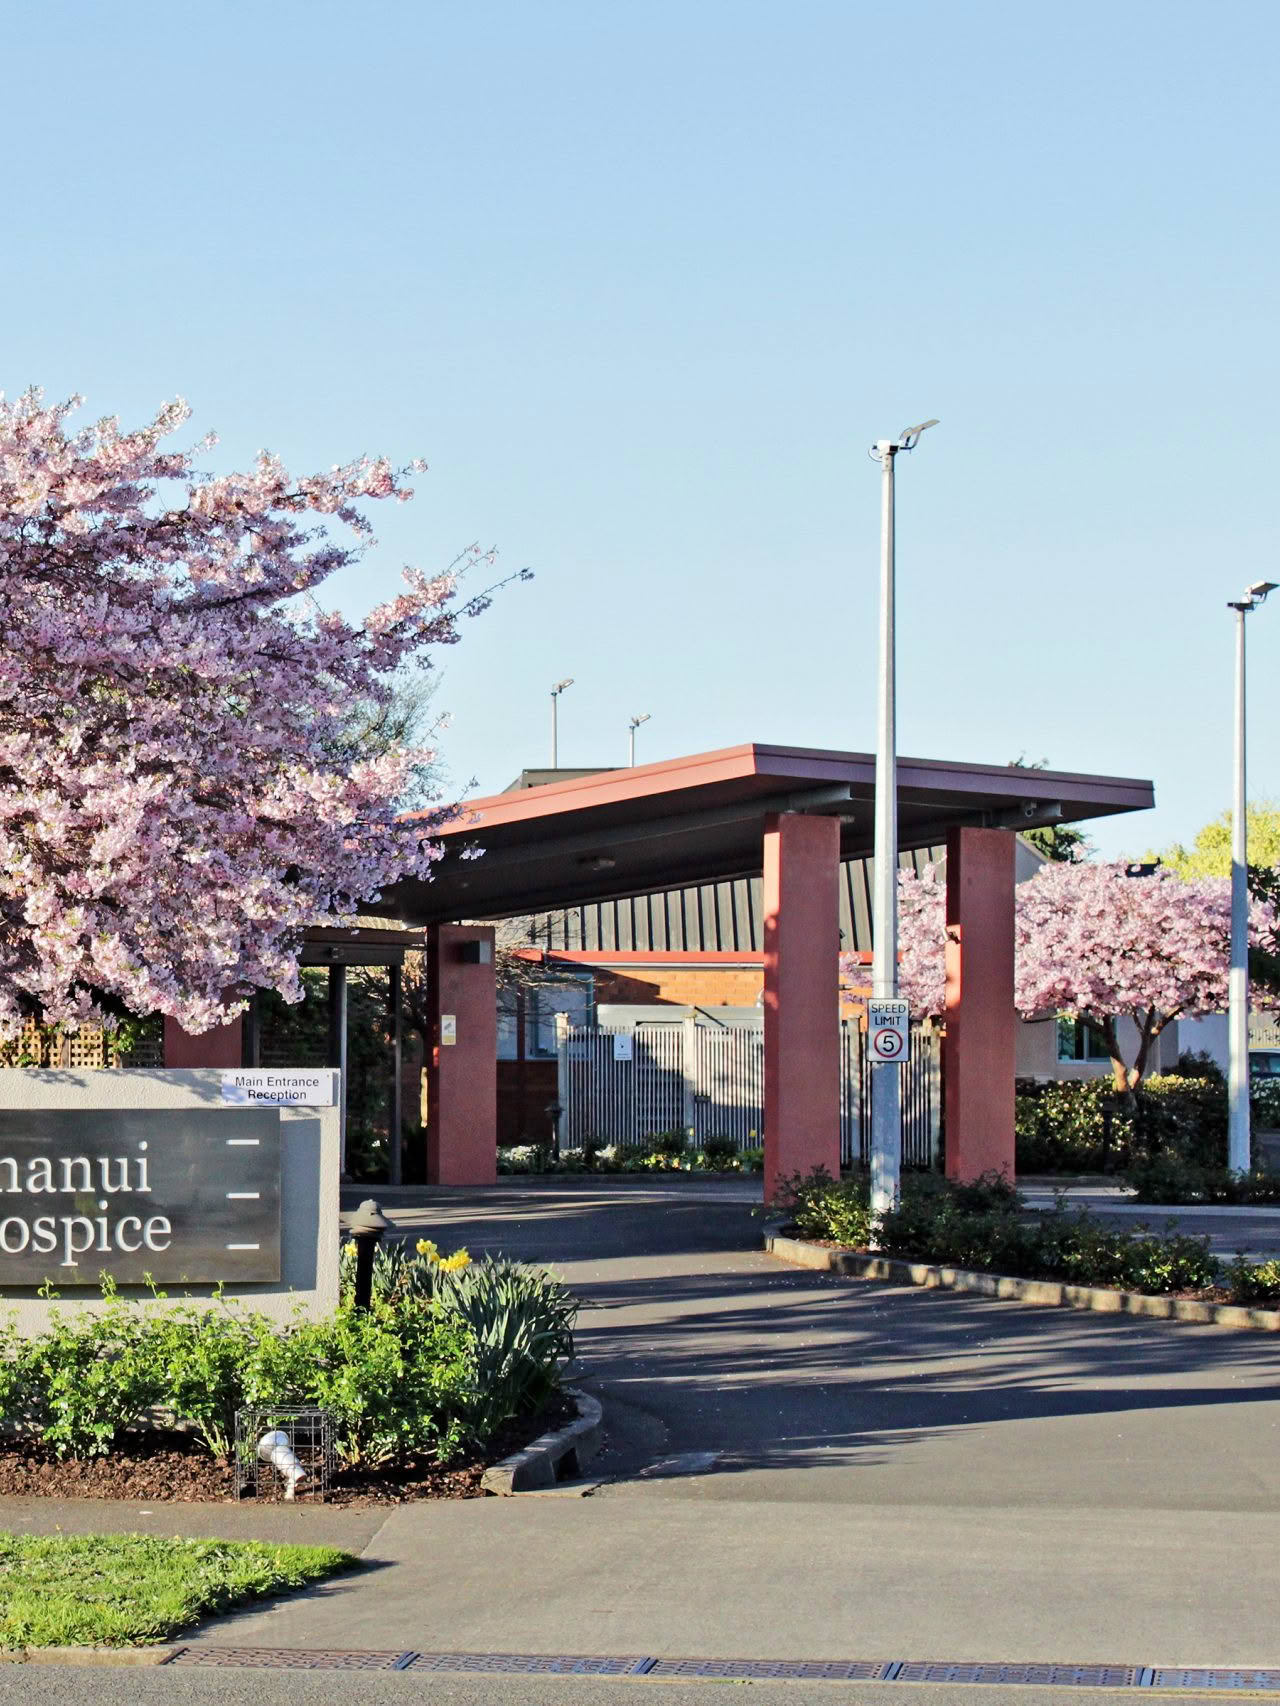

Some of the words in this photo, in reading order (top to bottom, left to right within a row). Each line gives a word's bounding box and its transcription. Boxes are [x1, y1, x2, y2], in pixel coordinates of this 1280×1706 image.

[871, 1003, 906, 1014] SPEED
[874, 1016, 901, 1026] LIMIT
[882, 1035, 895, 1052] 5
[235, 1076, 263, 1087] Main
[267, 1076, 319, 1087] Entrance
[248, 1089, 307, 1102] Reception
